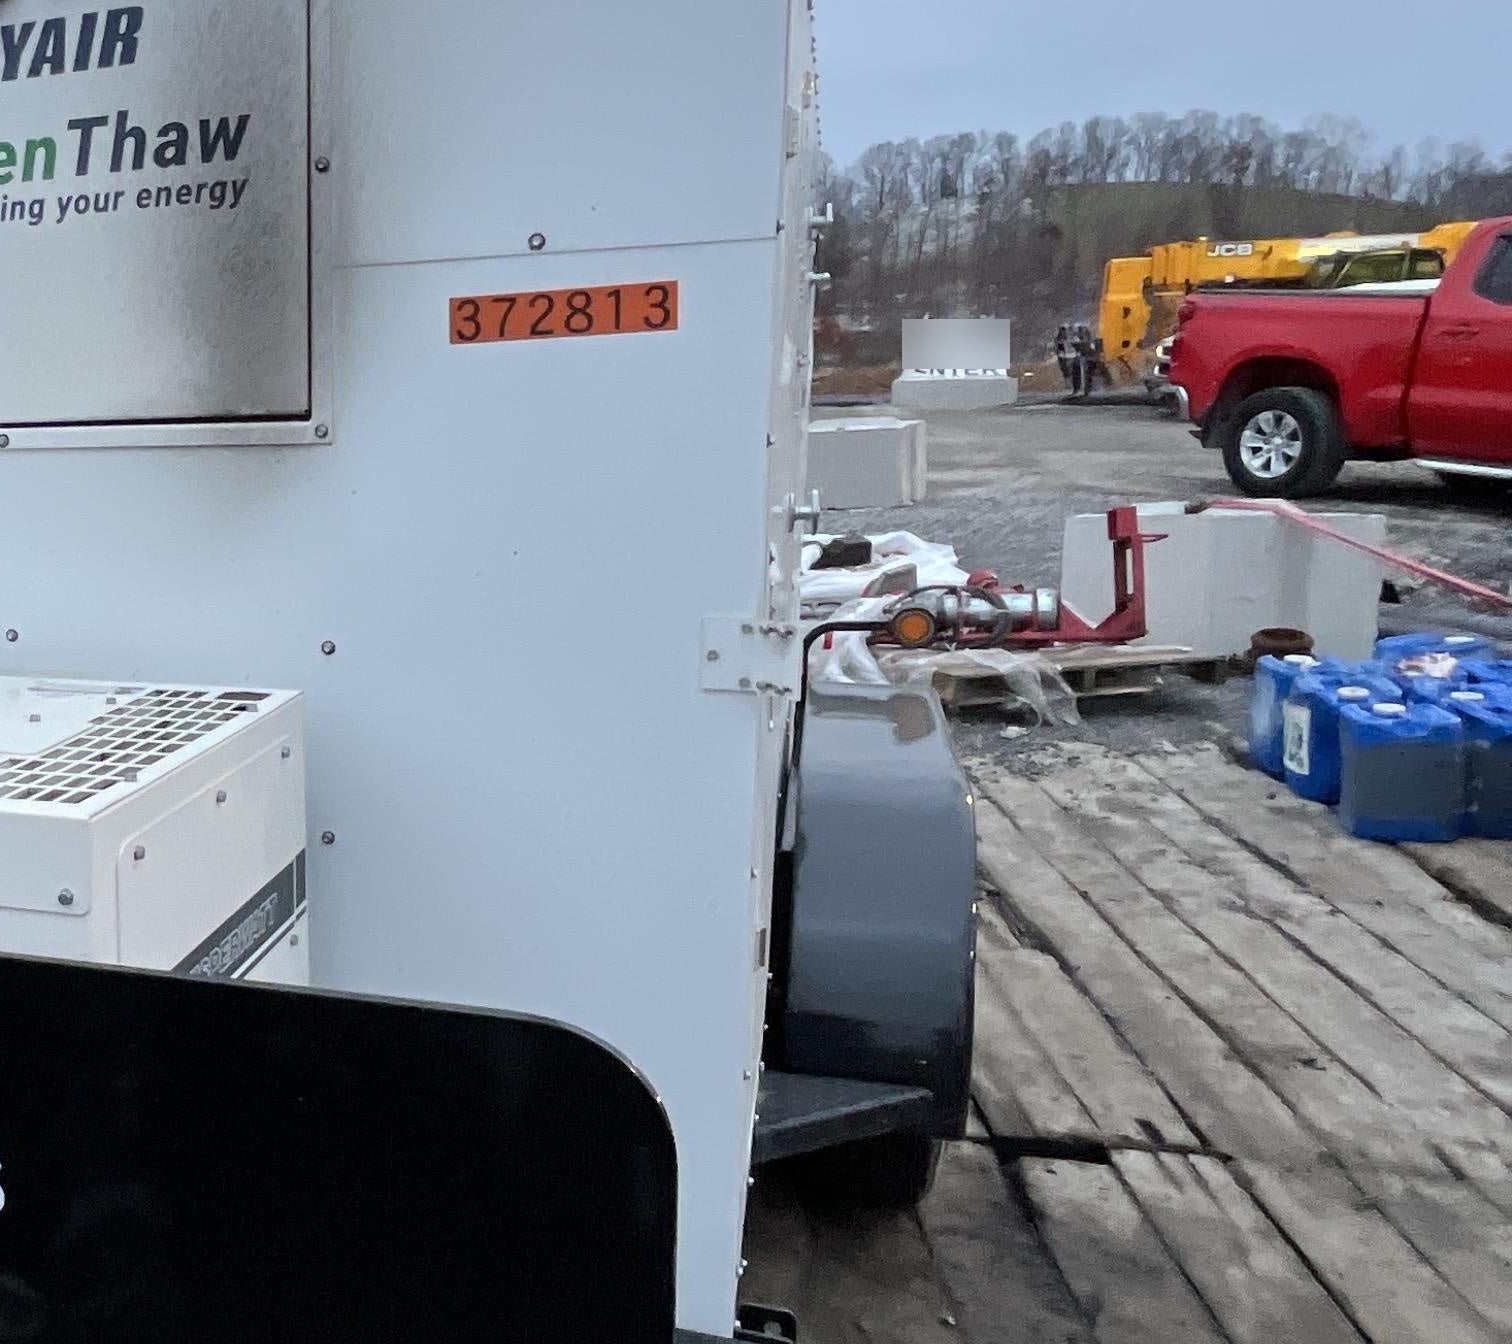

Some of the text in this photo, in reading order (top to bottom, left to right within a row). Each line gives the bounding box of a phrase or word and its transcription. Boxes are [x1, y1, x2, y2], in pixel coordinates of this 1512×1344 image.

[55, 189, 126, 226] your
[136, 177, 250, 210] energy
[1206, 243, 1253, 257] JCB
[455, 284, 672, 342] 372813
